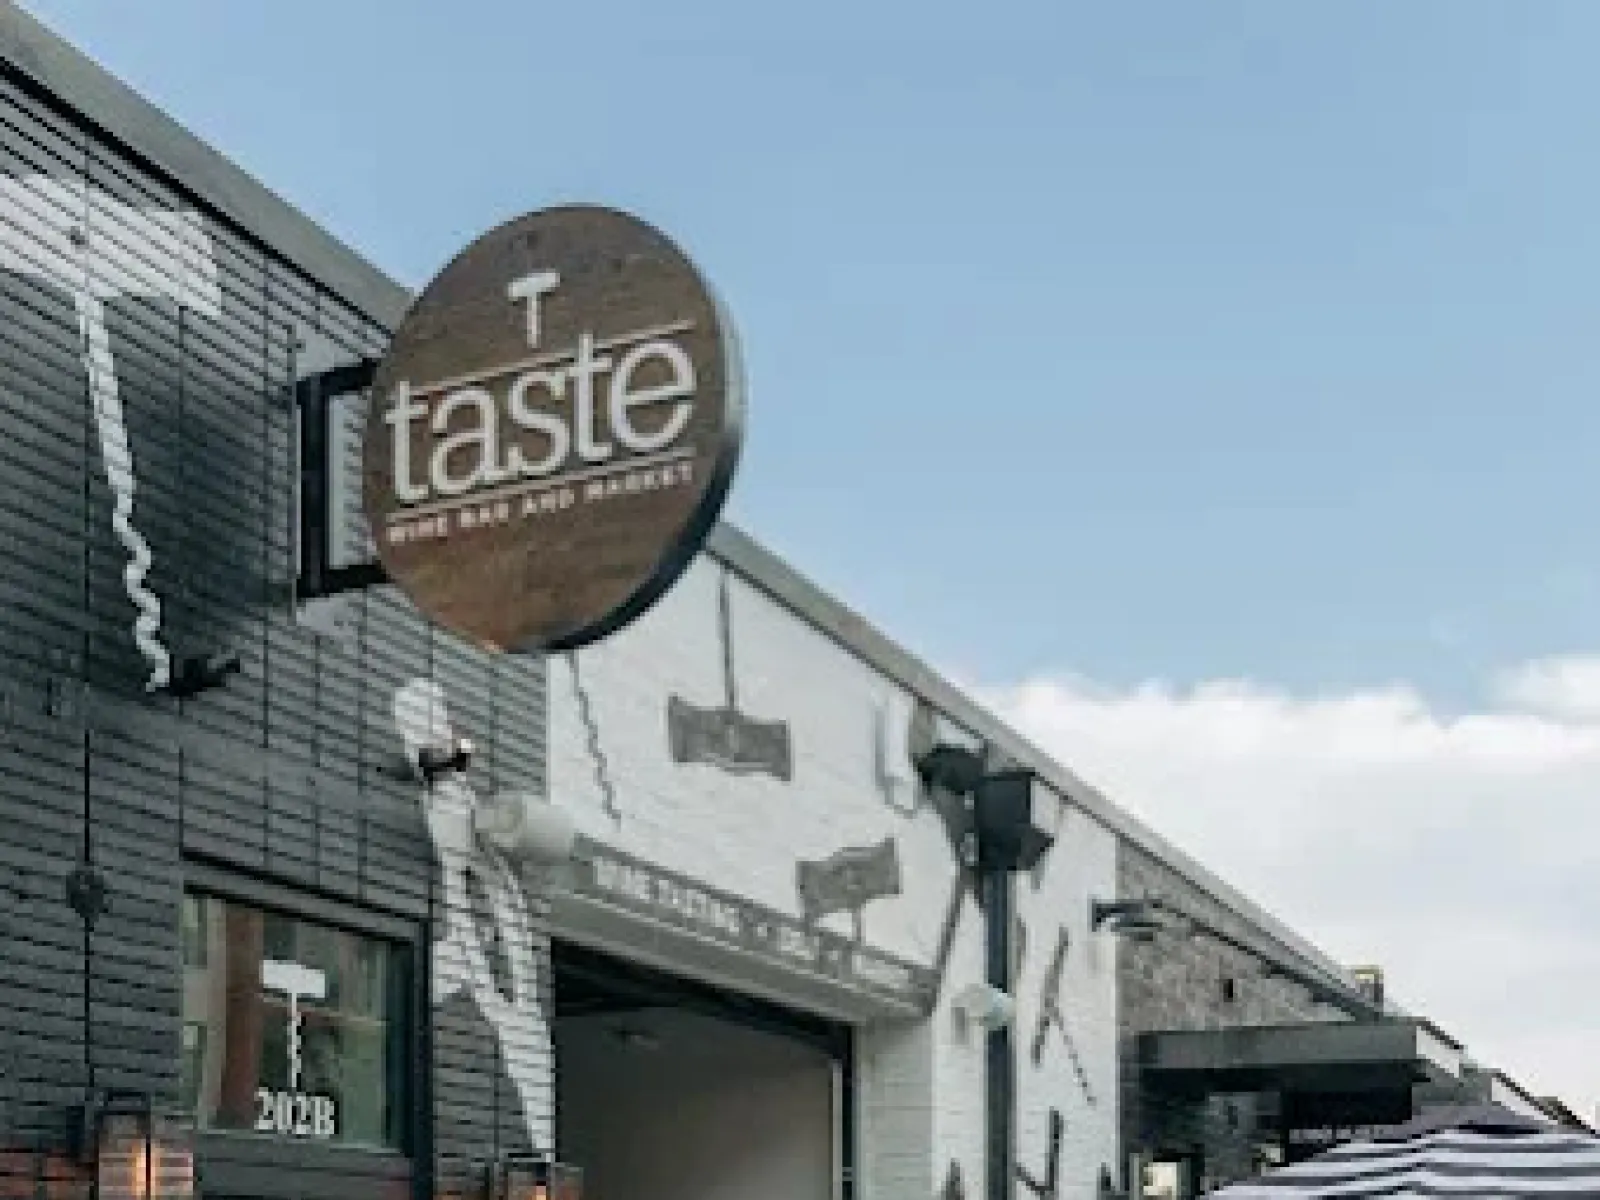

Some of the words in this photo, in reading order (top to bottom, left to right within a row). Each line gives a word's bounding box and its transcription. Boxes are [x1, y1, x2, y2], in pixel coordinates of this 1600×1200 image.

[385, 333, 698, 501] taste
[386, 513, 448, 546] WINE
[458, 502, 509, 528] BAR
[522, 488, 575, 517] AND
[584, 460, 693, 503] MARKET
[254, 1087, 335, 1135] 202B
